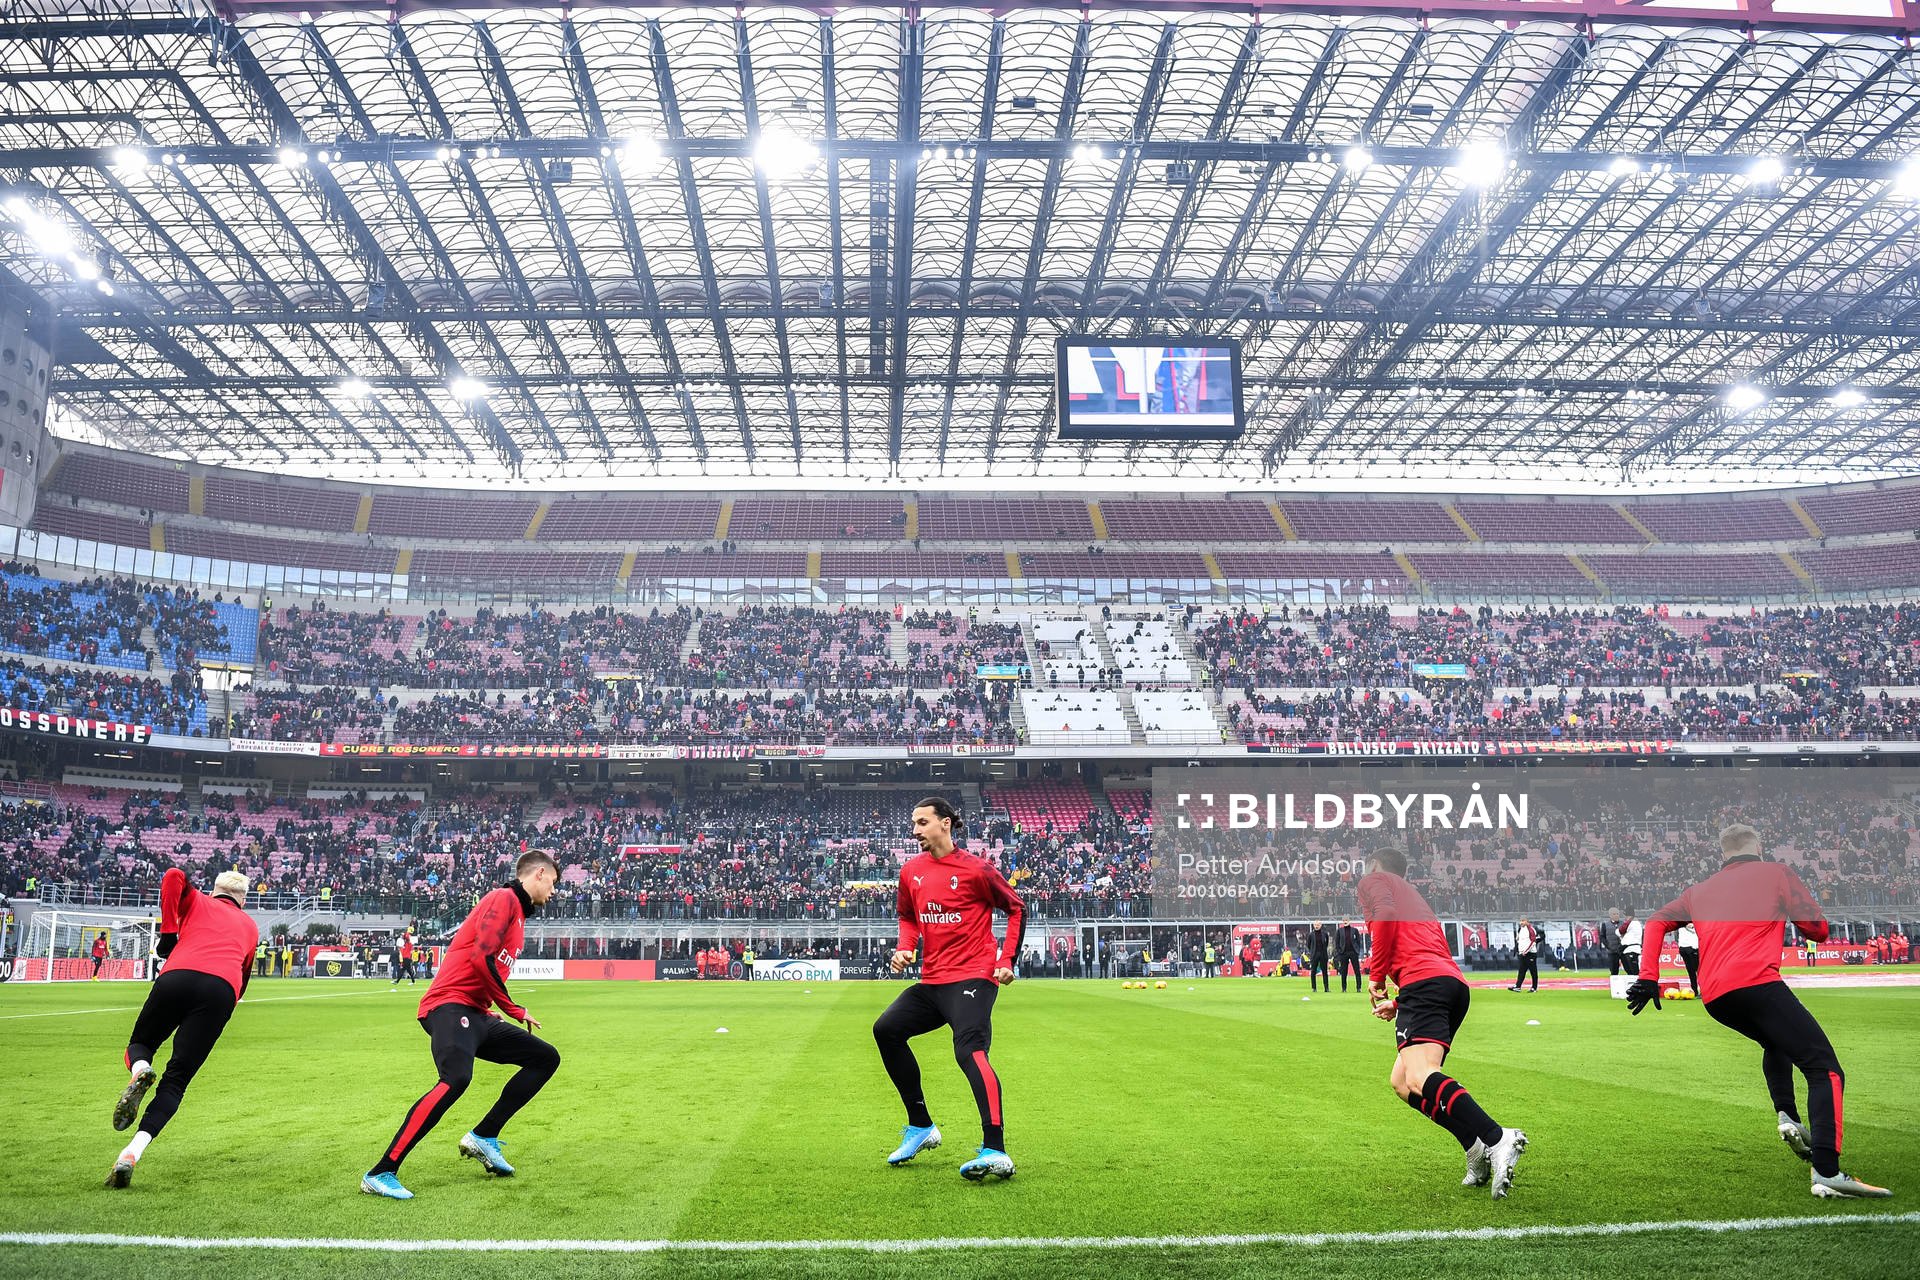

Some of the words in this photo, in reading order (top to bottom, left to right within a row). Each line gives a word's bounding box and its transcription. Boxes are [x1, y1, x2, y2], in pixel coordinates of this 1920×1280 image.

[342, 745, 384, 753] CUORE
[387, 745, 460, 753] ROSSONERO
[1328, 741, 1397, 755] BELLUSCO
[1413, 741, 1480, 755] SKIZZATO
[927, 902, 942, 912] Fly
[918, 910, 962, 924] mirates
[1797, 949, 1840, 960] Erates
[755, 969, 803, 980] BANCO
[806, 969, 832, 980] BPM
